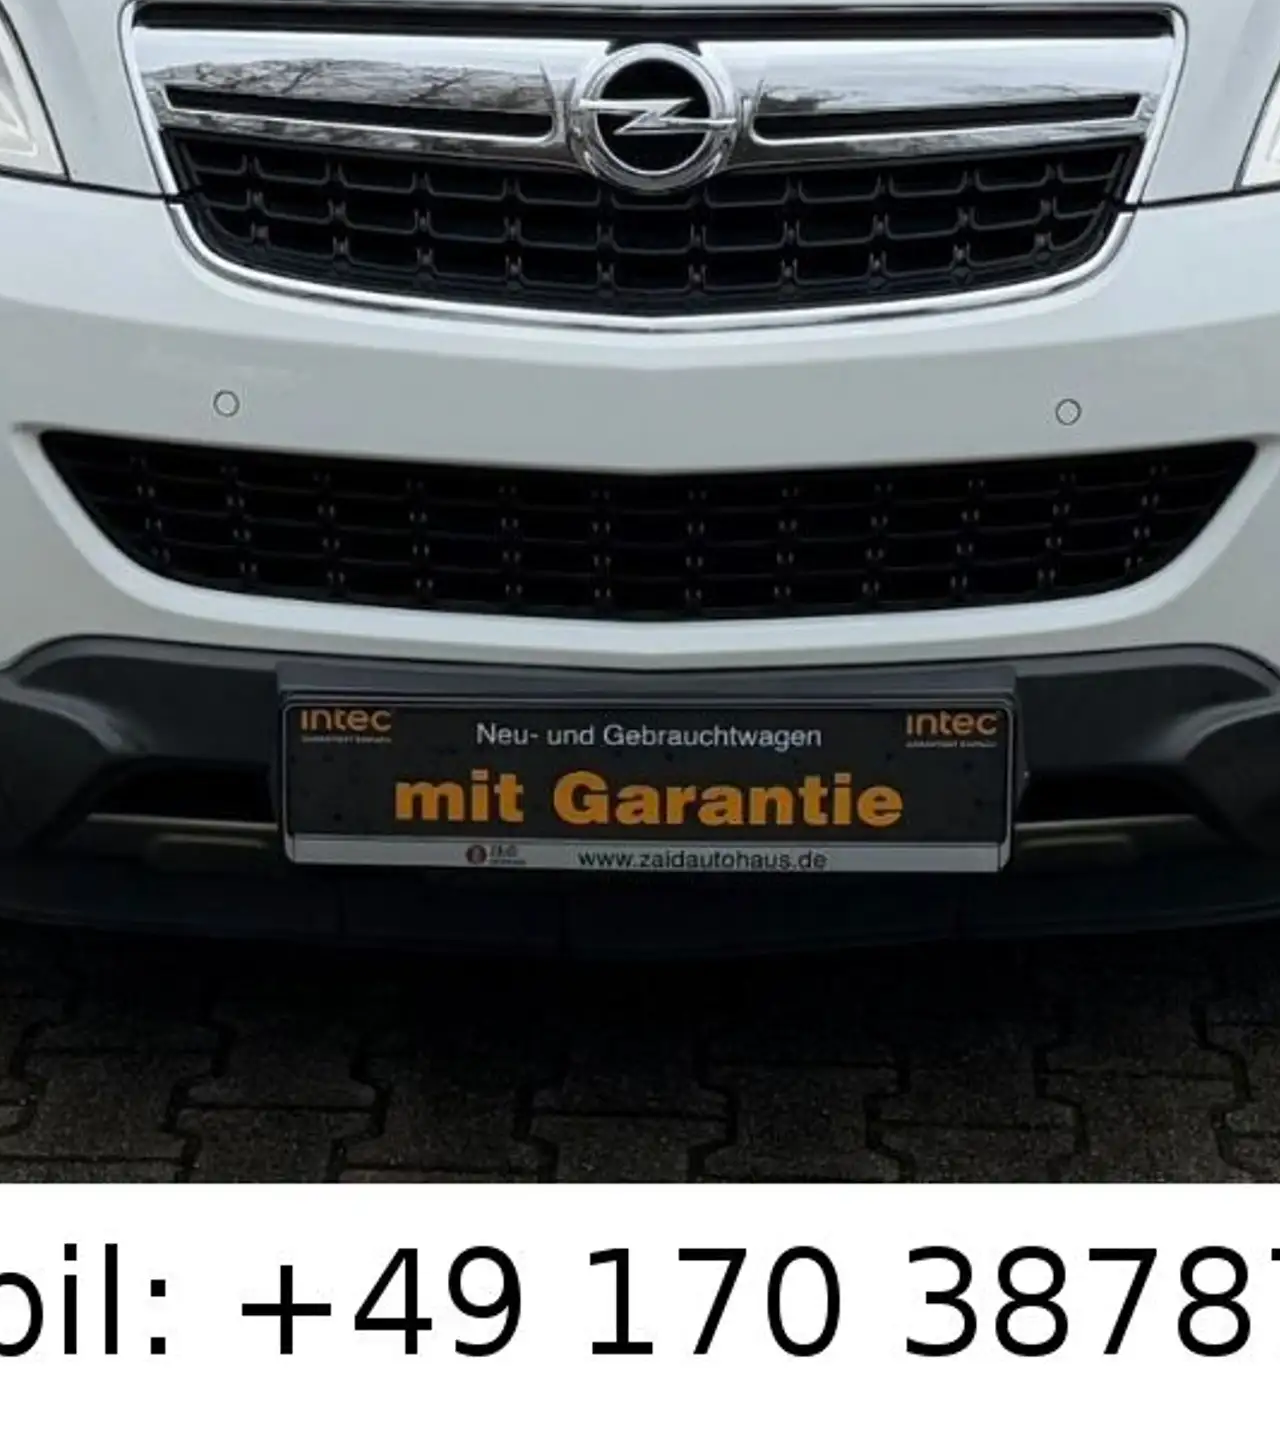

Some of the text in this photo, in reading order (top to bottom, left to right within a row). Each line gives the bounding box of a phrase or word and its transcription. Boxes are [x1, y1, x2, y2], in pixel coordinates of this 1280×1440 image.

[475, 721, 823, 752] Neu- und Gebrauchtwagen
[394, 767, 904, 828] mit Garantie
[577, 849, 828, 871] www.zaidautohaus.de
